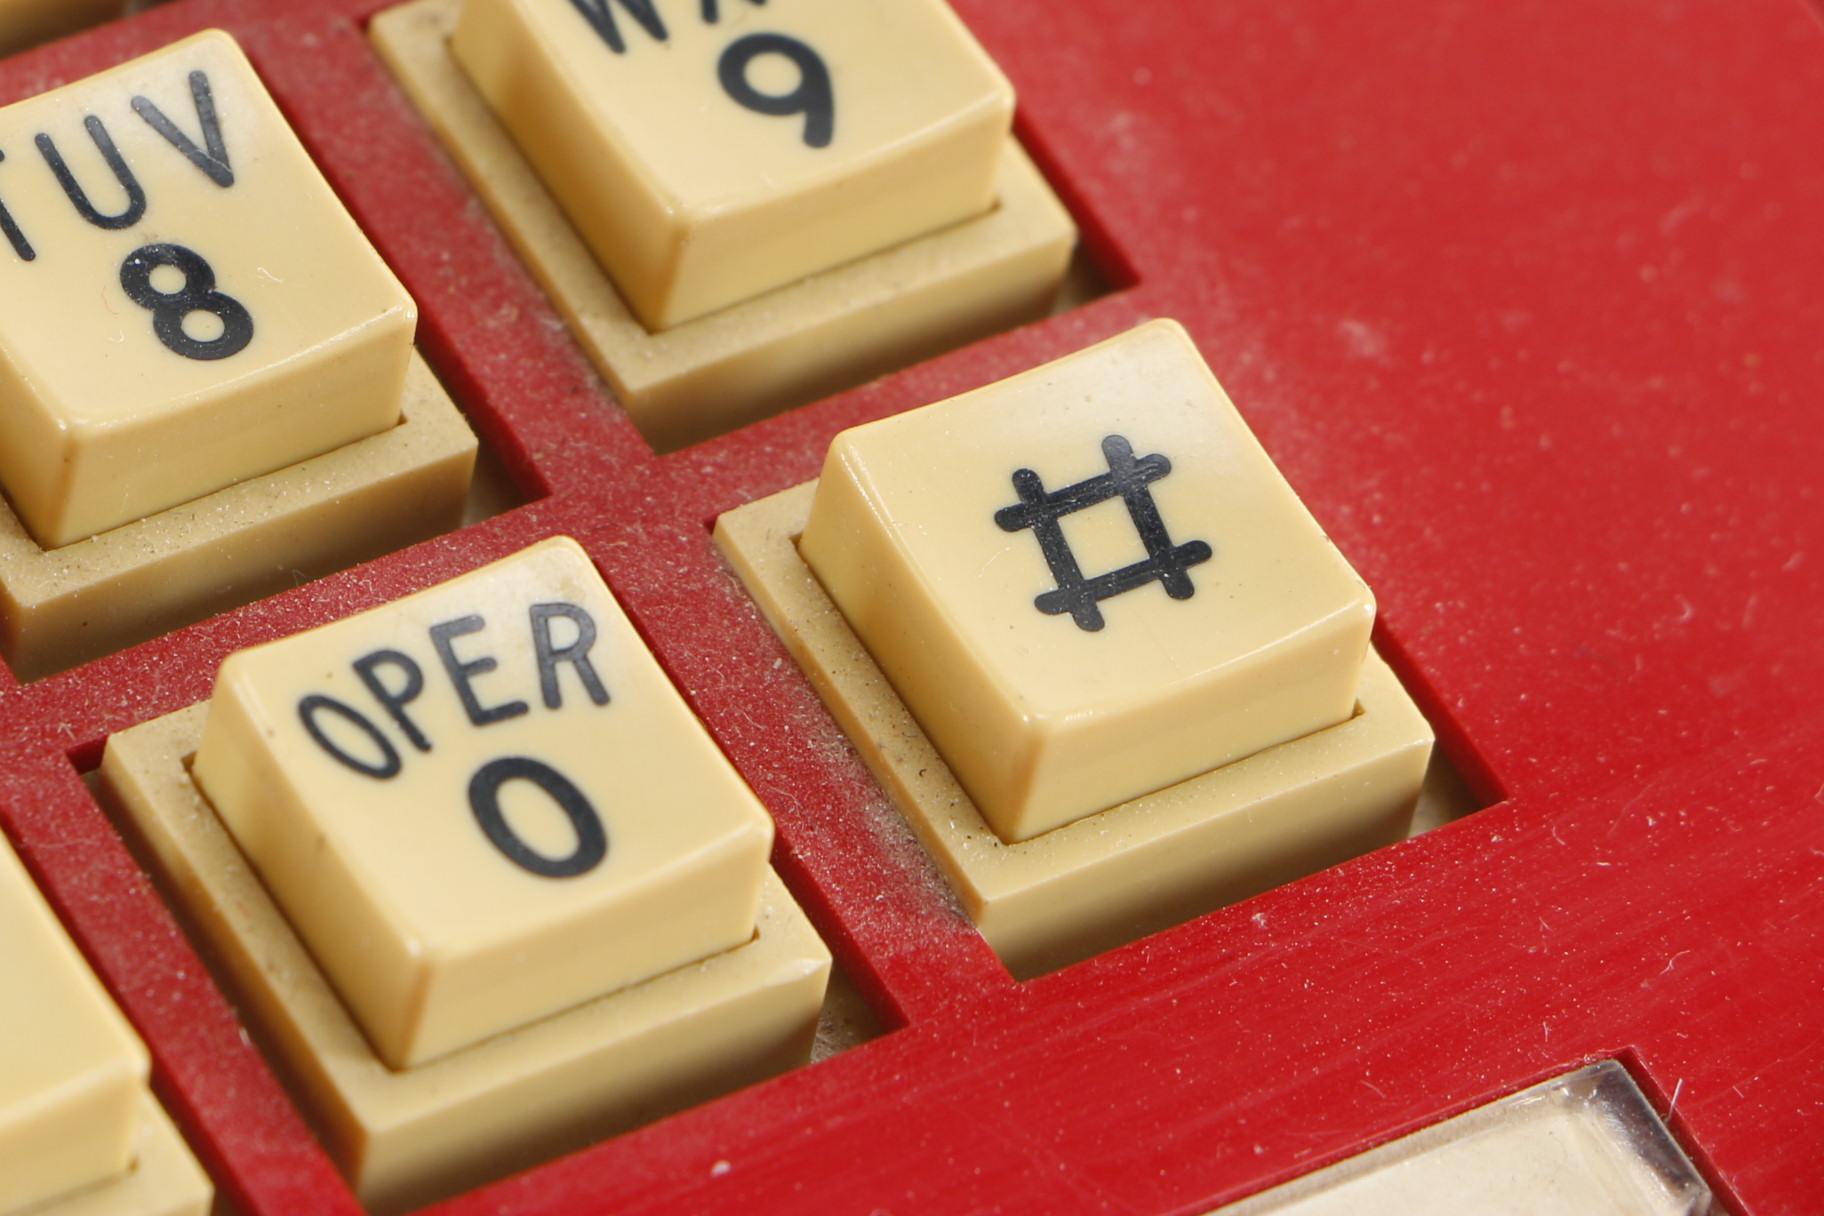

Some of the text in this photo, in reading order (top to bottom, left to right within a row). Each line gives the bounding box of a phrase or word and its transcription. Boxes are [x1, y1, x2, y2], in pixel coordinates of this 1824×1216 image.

[717, 33, 836, 149] 9
[119, 243, 254, 361] 8
[993, 435, 1213, 632] #
[297, 601, 610, 781] OPER
